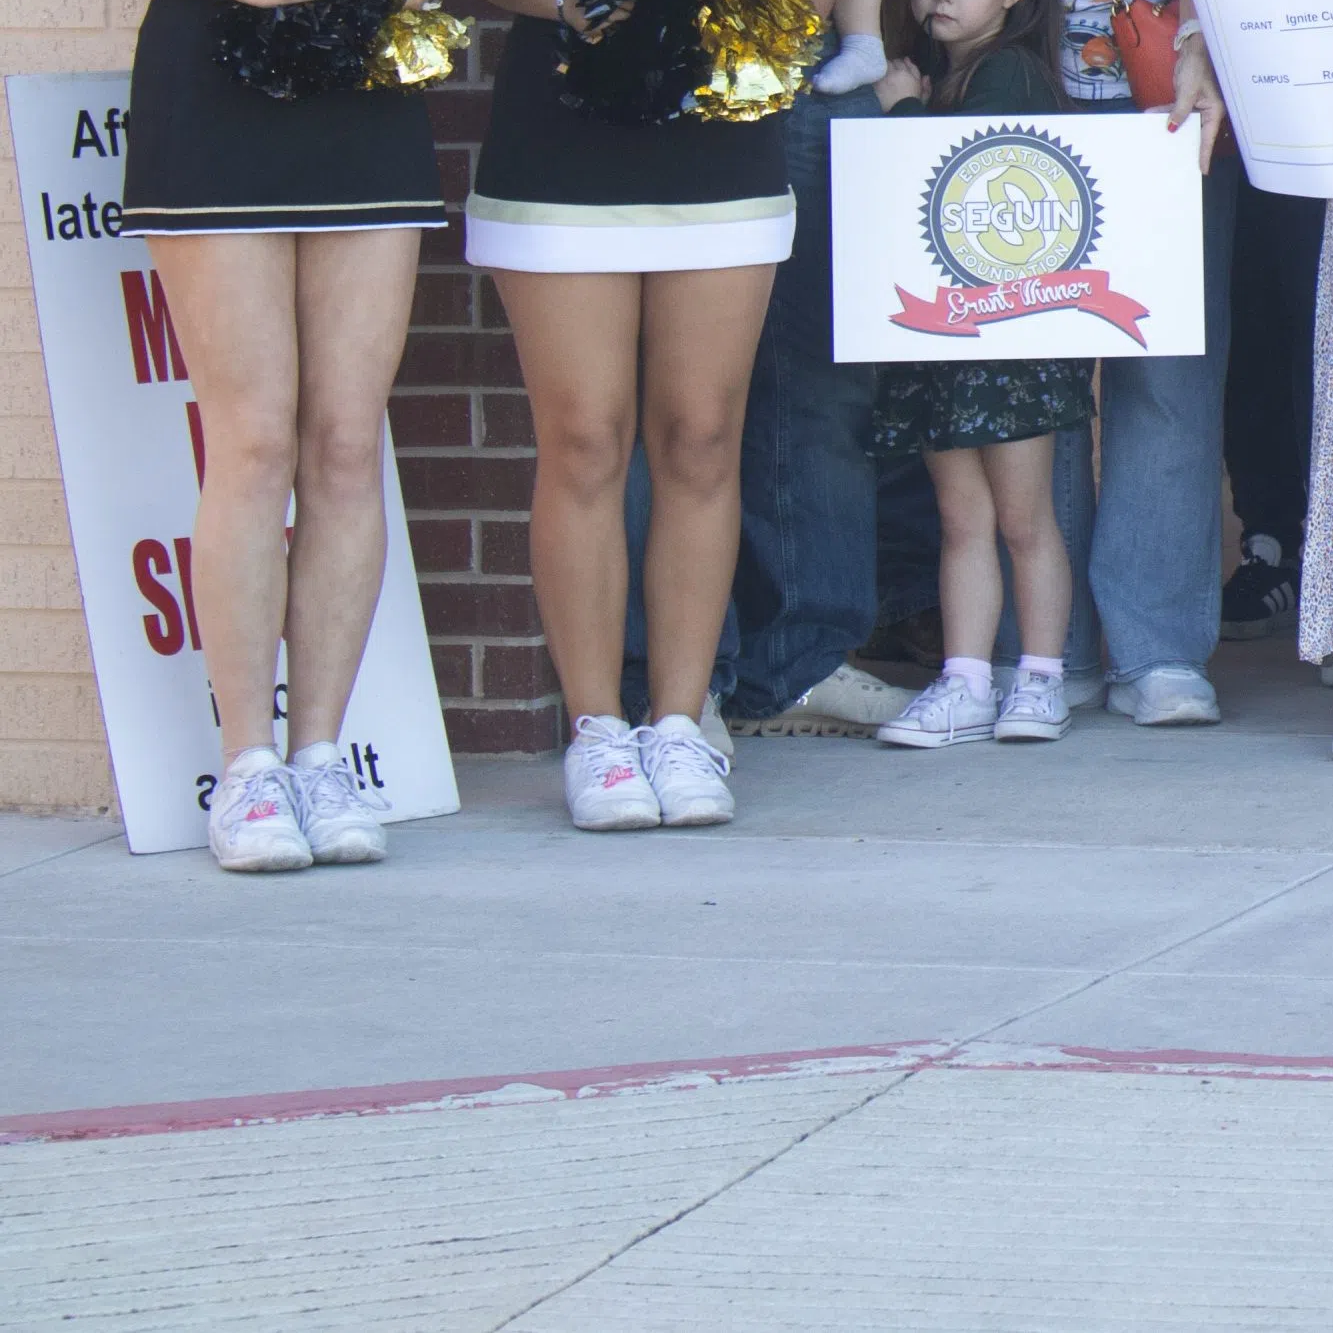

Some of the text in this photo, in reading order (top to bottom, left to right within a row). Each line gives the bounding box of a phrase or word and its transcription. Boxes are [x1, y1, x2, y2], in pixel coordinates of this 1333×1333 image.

[1240, 21, 1272, 31] GRANT
[1286, 14, 1318, 26] Ignite
[1252, 75, 1289, 84] CAMPUS
[958, 147, 1064, 183] EDUCATION
[41, 192, 123, 240] late
[941, 200, 1080, 233] SEGUIN
[954, 242, 1070, 282] FOUNDATION
[948, 278, 1091, 323] Grant Winner
